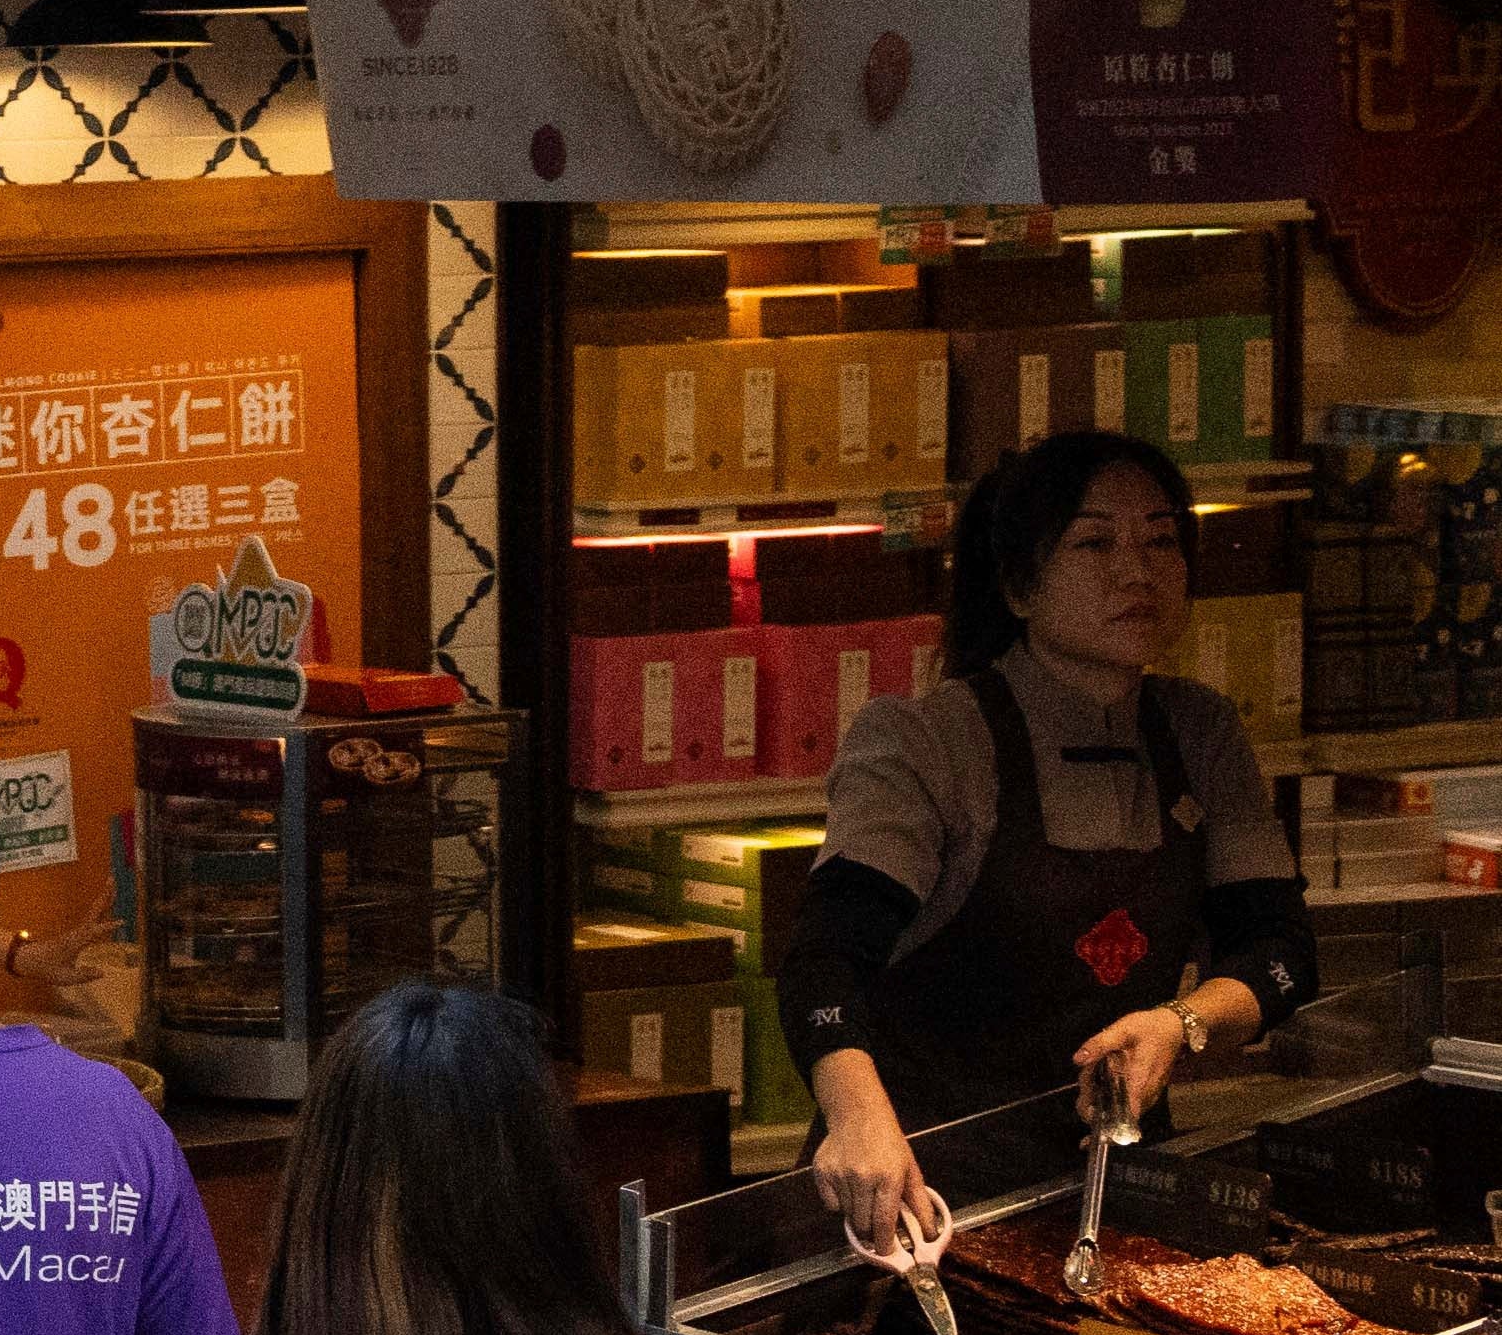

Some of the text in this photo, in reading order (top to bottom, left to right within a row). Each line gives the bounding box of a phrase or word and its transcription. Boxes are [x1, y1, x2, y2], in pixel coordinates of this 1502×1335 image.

[123, 476, 301, 538] 任選三盒
[1411, 1279, 1471, 1317] $138
